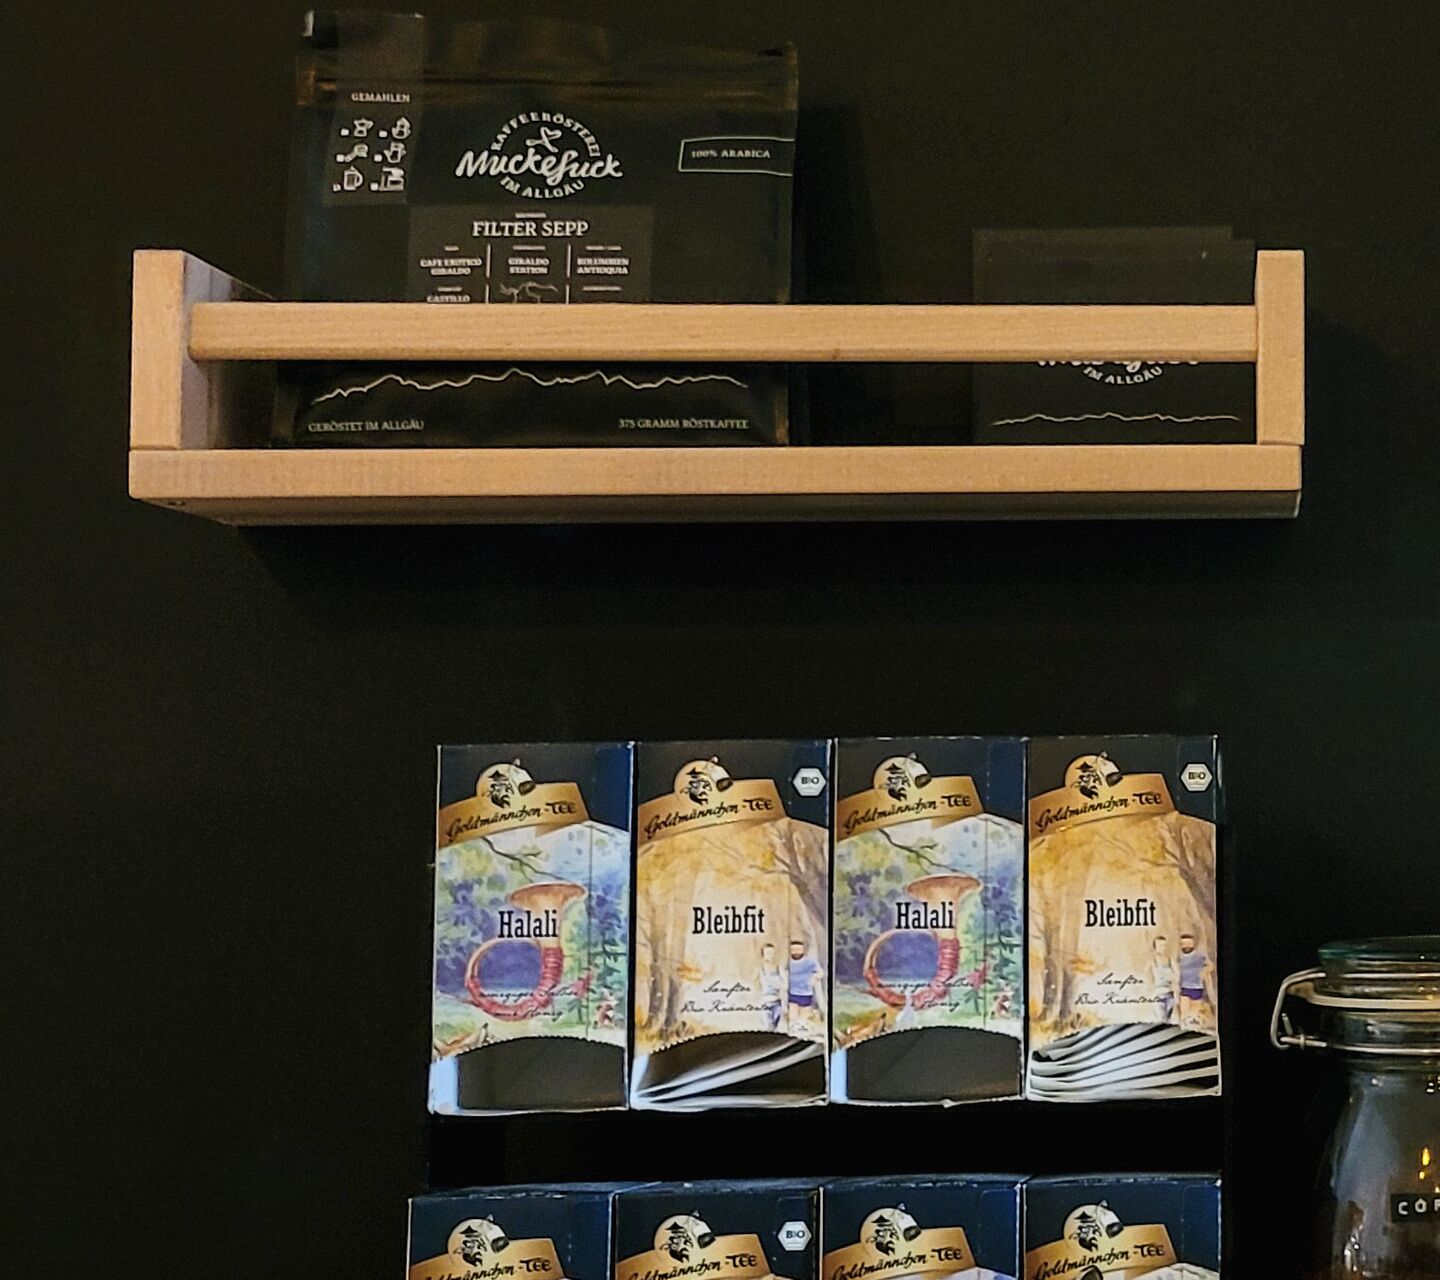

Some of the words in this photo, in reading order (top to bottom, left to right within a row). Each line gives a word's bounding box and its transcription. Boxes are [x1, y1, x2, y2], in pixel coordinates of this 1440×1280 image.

[351, 92, 411, 103] GEMAHLEN
[691, 149, 718, 158] 100%
[721, 149, 771, 158] ARABICA
[455, 147, 624, 187] Muckefuck
[500, 176, 521, 194] IM
[471, 221, 537, 237] FILTER
[541, 220, 589, 237] SEPP
[1083, 366, 1103, 381] IM
[637, 419, 680, 429] GRAMM
[801, 776, 820, 785] BIO
[692, 905, 766, 934] Bleibfit
[895, 901, 956, 930] Halali
[1085, 898, 1157, 928] Bleibfit
[497, 909, 559, 938] Halali
[785, 1229, 805, 1239] BIO
